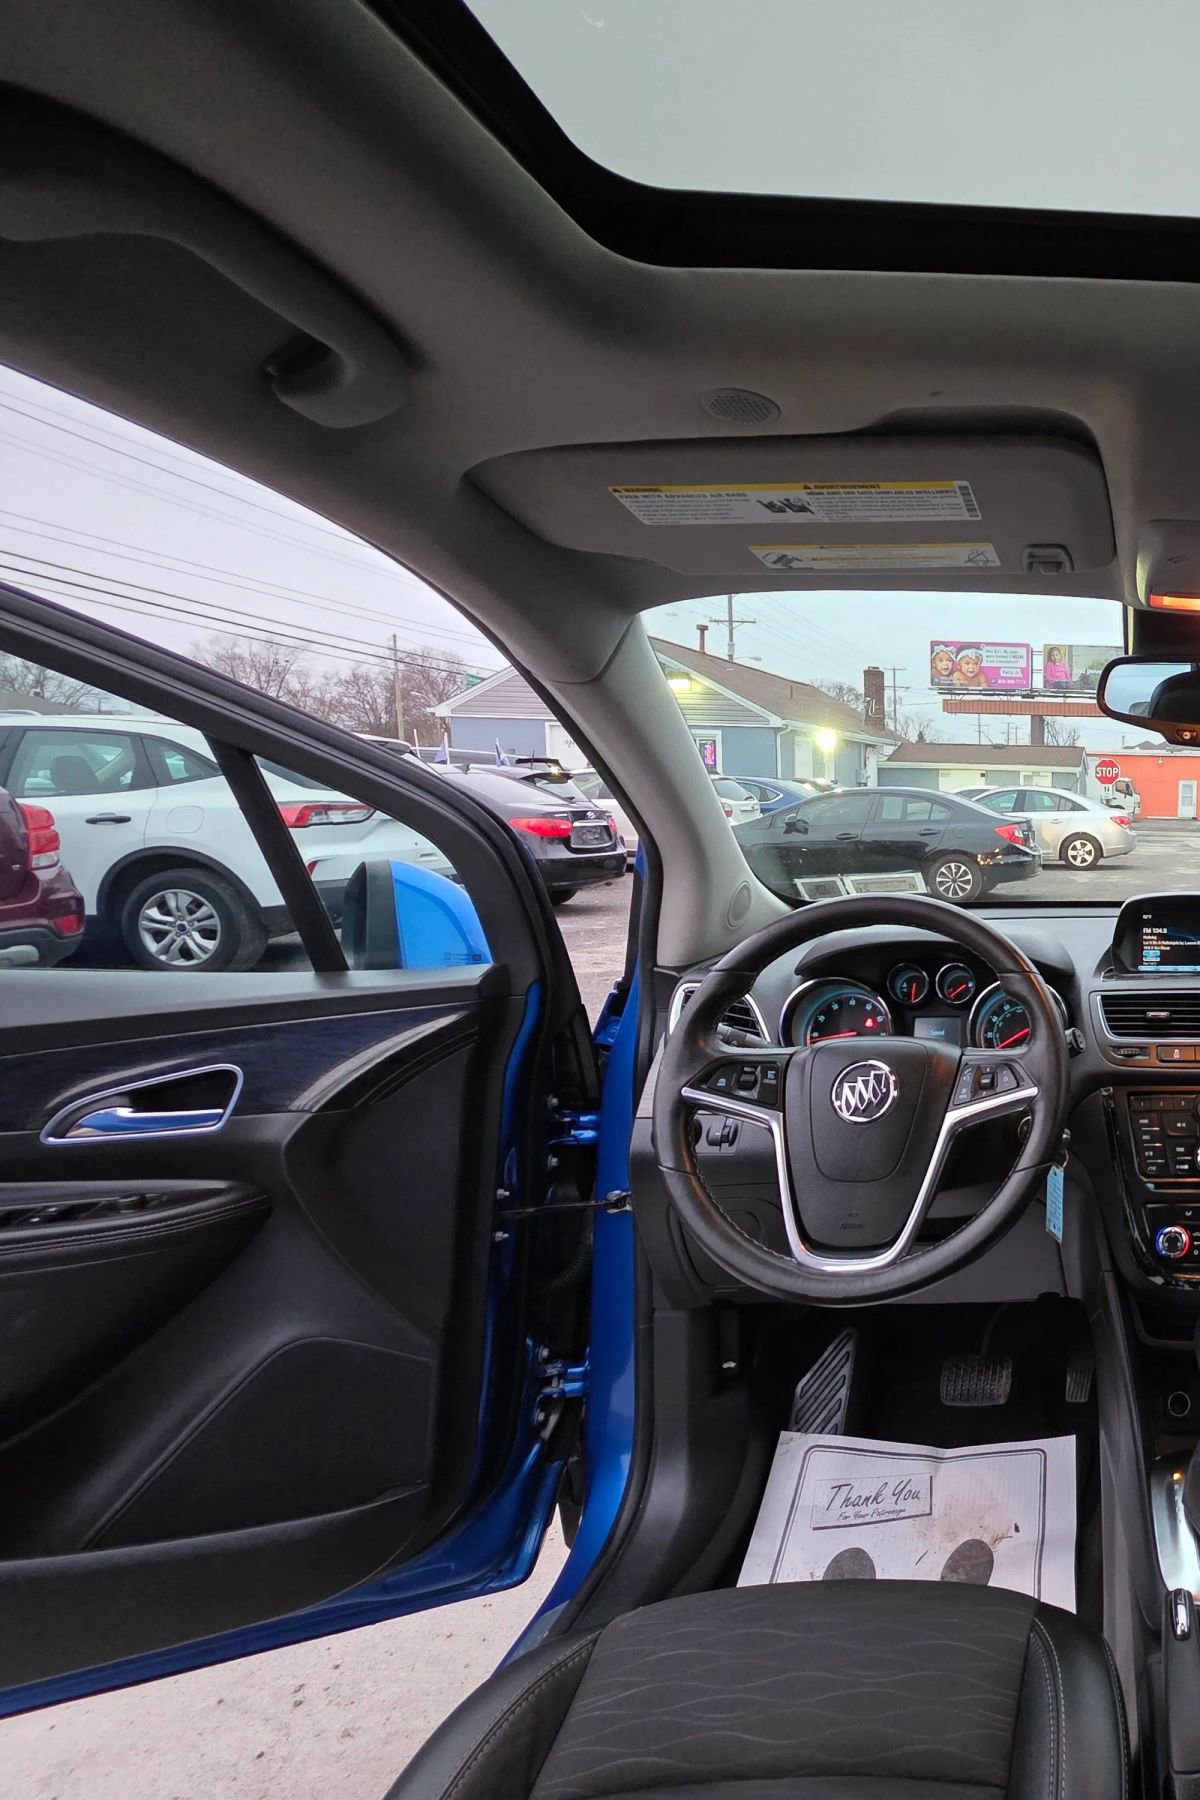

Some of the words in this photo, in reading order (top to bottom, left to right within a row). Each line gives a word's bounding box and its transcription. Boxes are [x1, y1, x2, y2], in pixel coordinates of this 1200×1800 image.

[1096, 767, 1119, 778] STOP
[826, 1482, 888, 1511] Thank
[892, 1479, 920, 1505] You
[838, 1511, 850, 1521] For
[852, 1510, 869, 1520] Your
